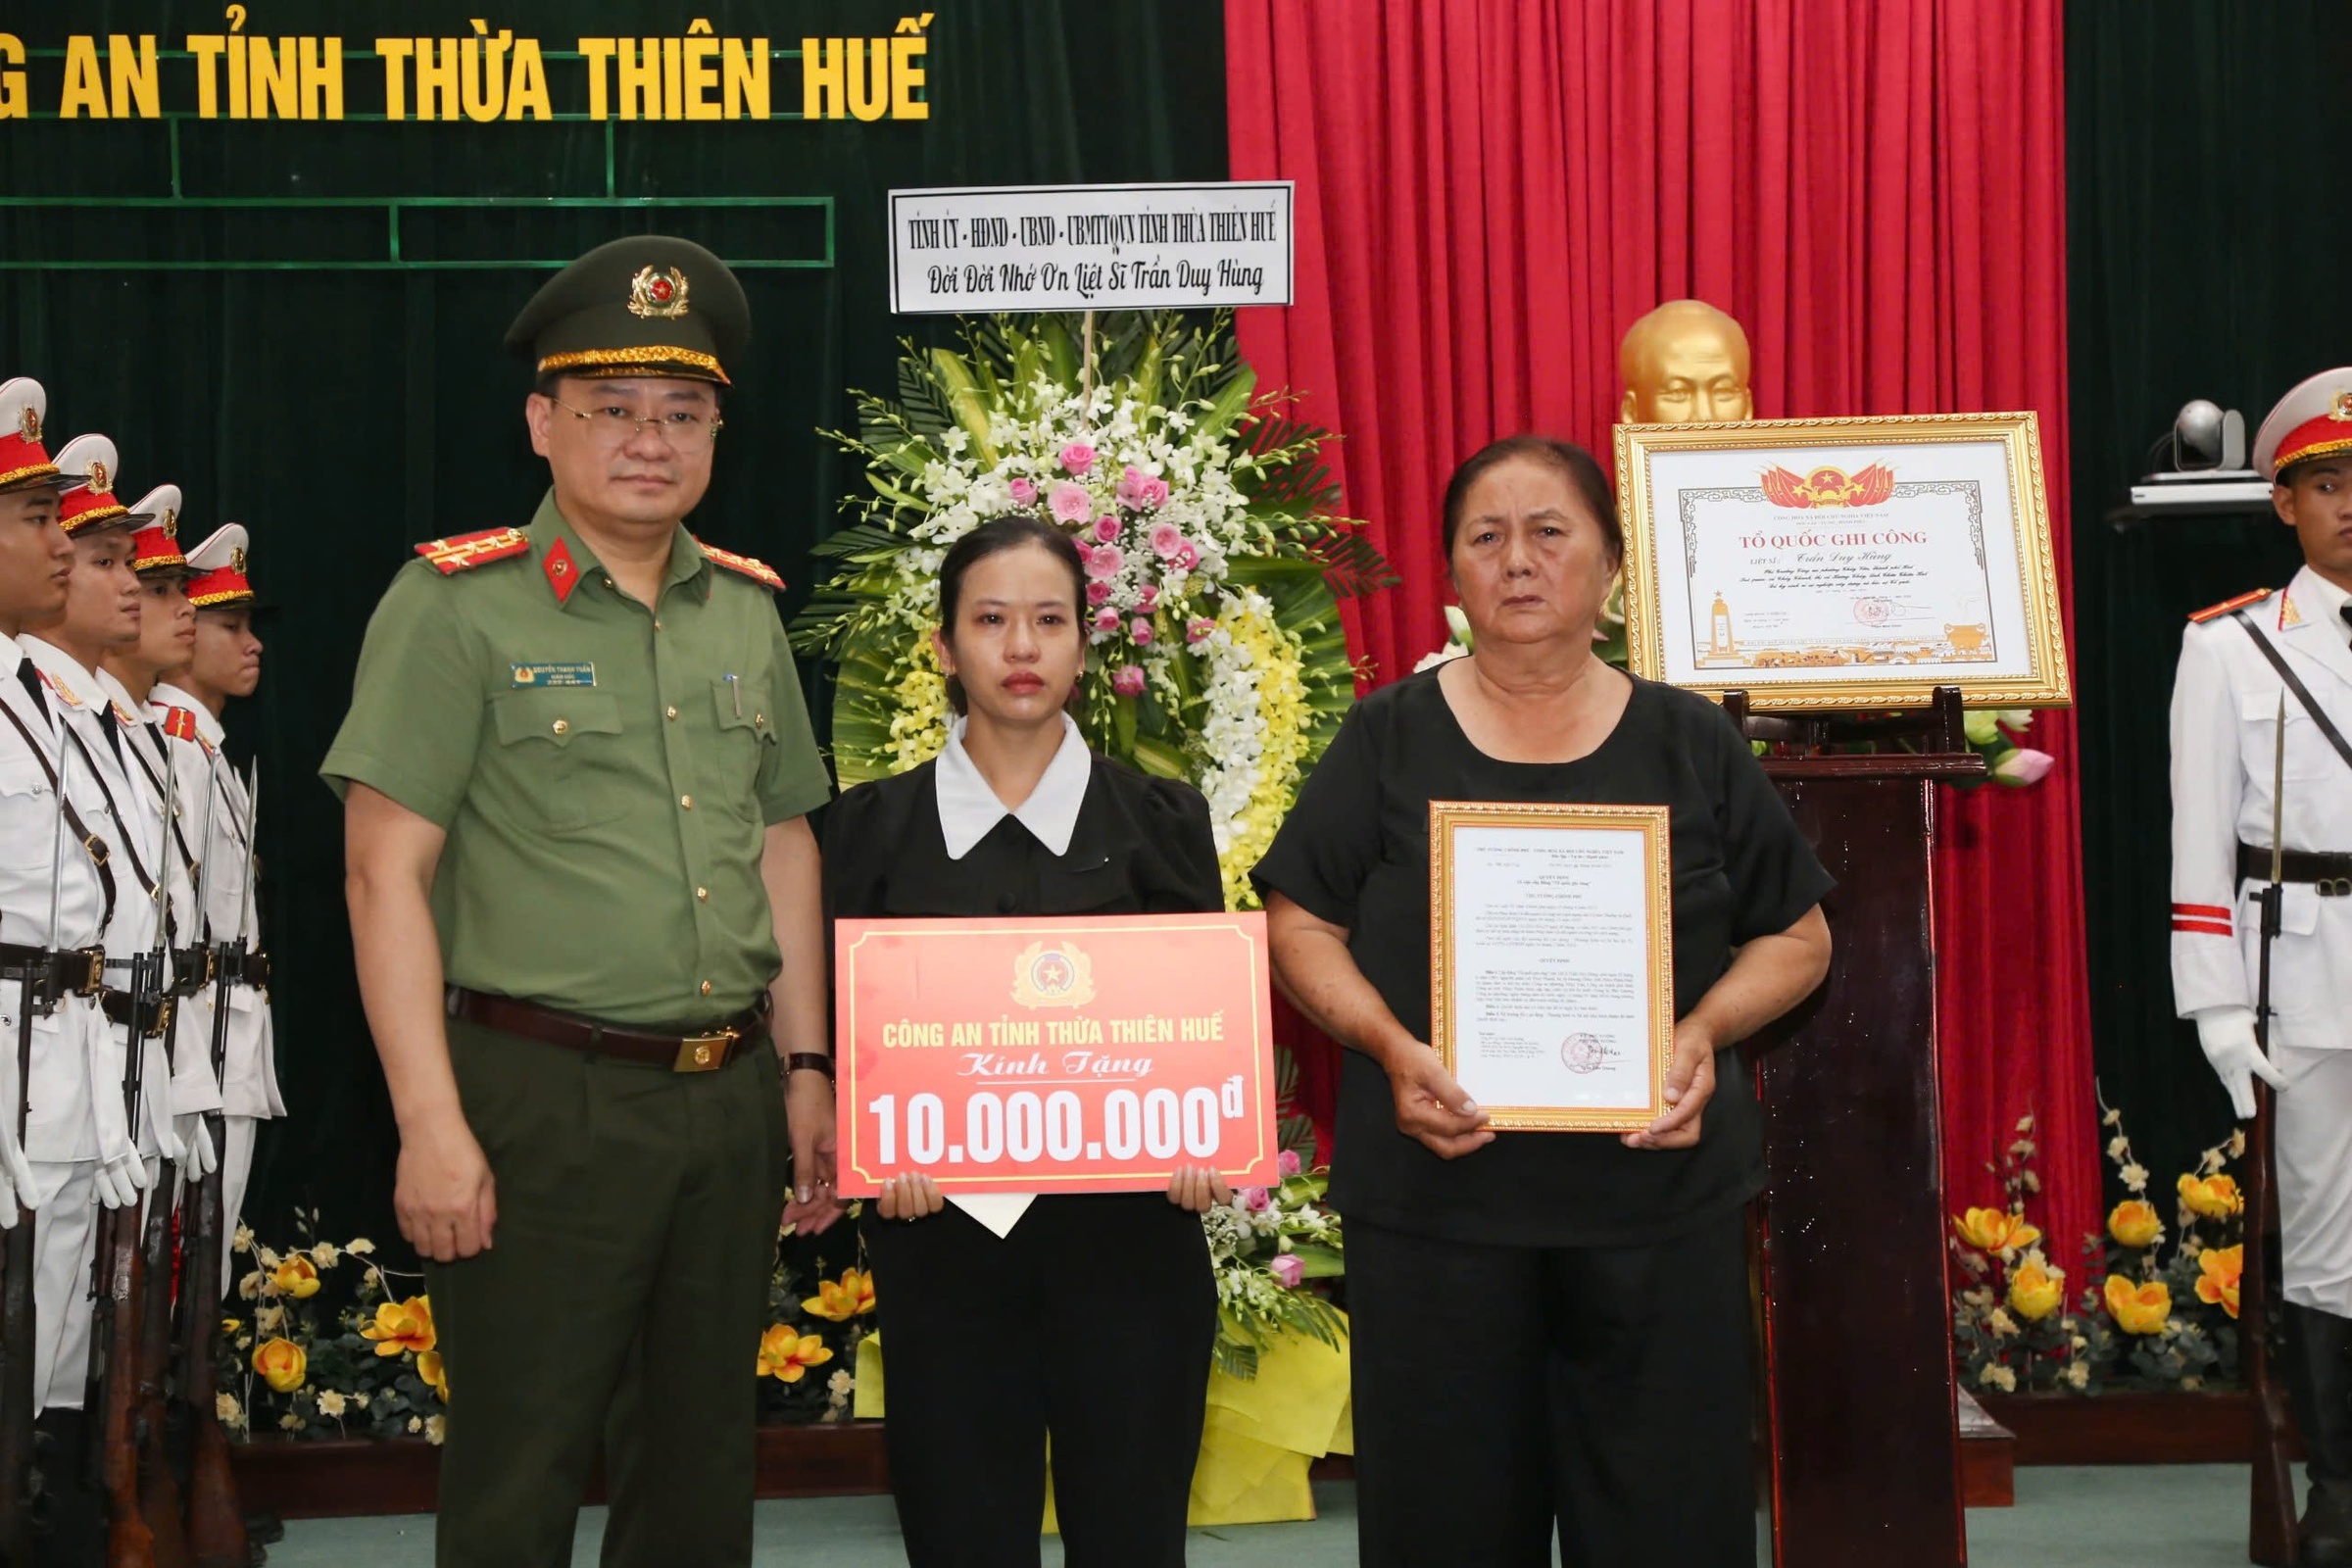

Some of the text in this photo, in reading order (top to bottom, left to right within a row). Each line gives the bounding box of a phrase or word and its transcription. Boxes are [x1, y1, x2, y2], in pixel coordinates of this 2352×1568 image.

[60, 35, 157, 119] AN
[187, 4, 344, 119] TỈNH
[376, 19, 553, 122] THỪA
[579, 18, 770, 121] THIÊN
[803, 12, 935, 122] HUẾ
[970, 217, 1008, 248] HĐND
[1020, 216, 1055, 247] UBND
[1208, 204, 1248, 242] THIÊN
[1250, 198, 1277, 242] HUẾ
[927, 254, 1264, 299] Đời Đời Nhớ Ơn Liệt Sĩ Trần Duy Hùng
[1739, 528, 1927, 550] TỔ QUỐC GHI CÔNG
[883, 1007, 1225, 1048] CÔNG AN TỈNH THỪA THIÊN HUẾ
[956, 1051, 1154, 1078] Kính Tặng
